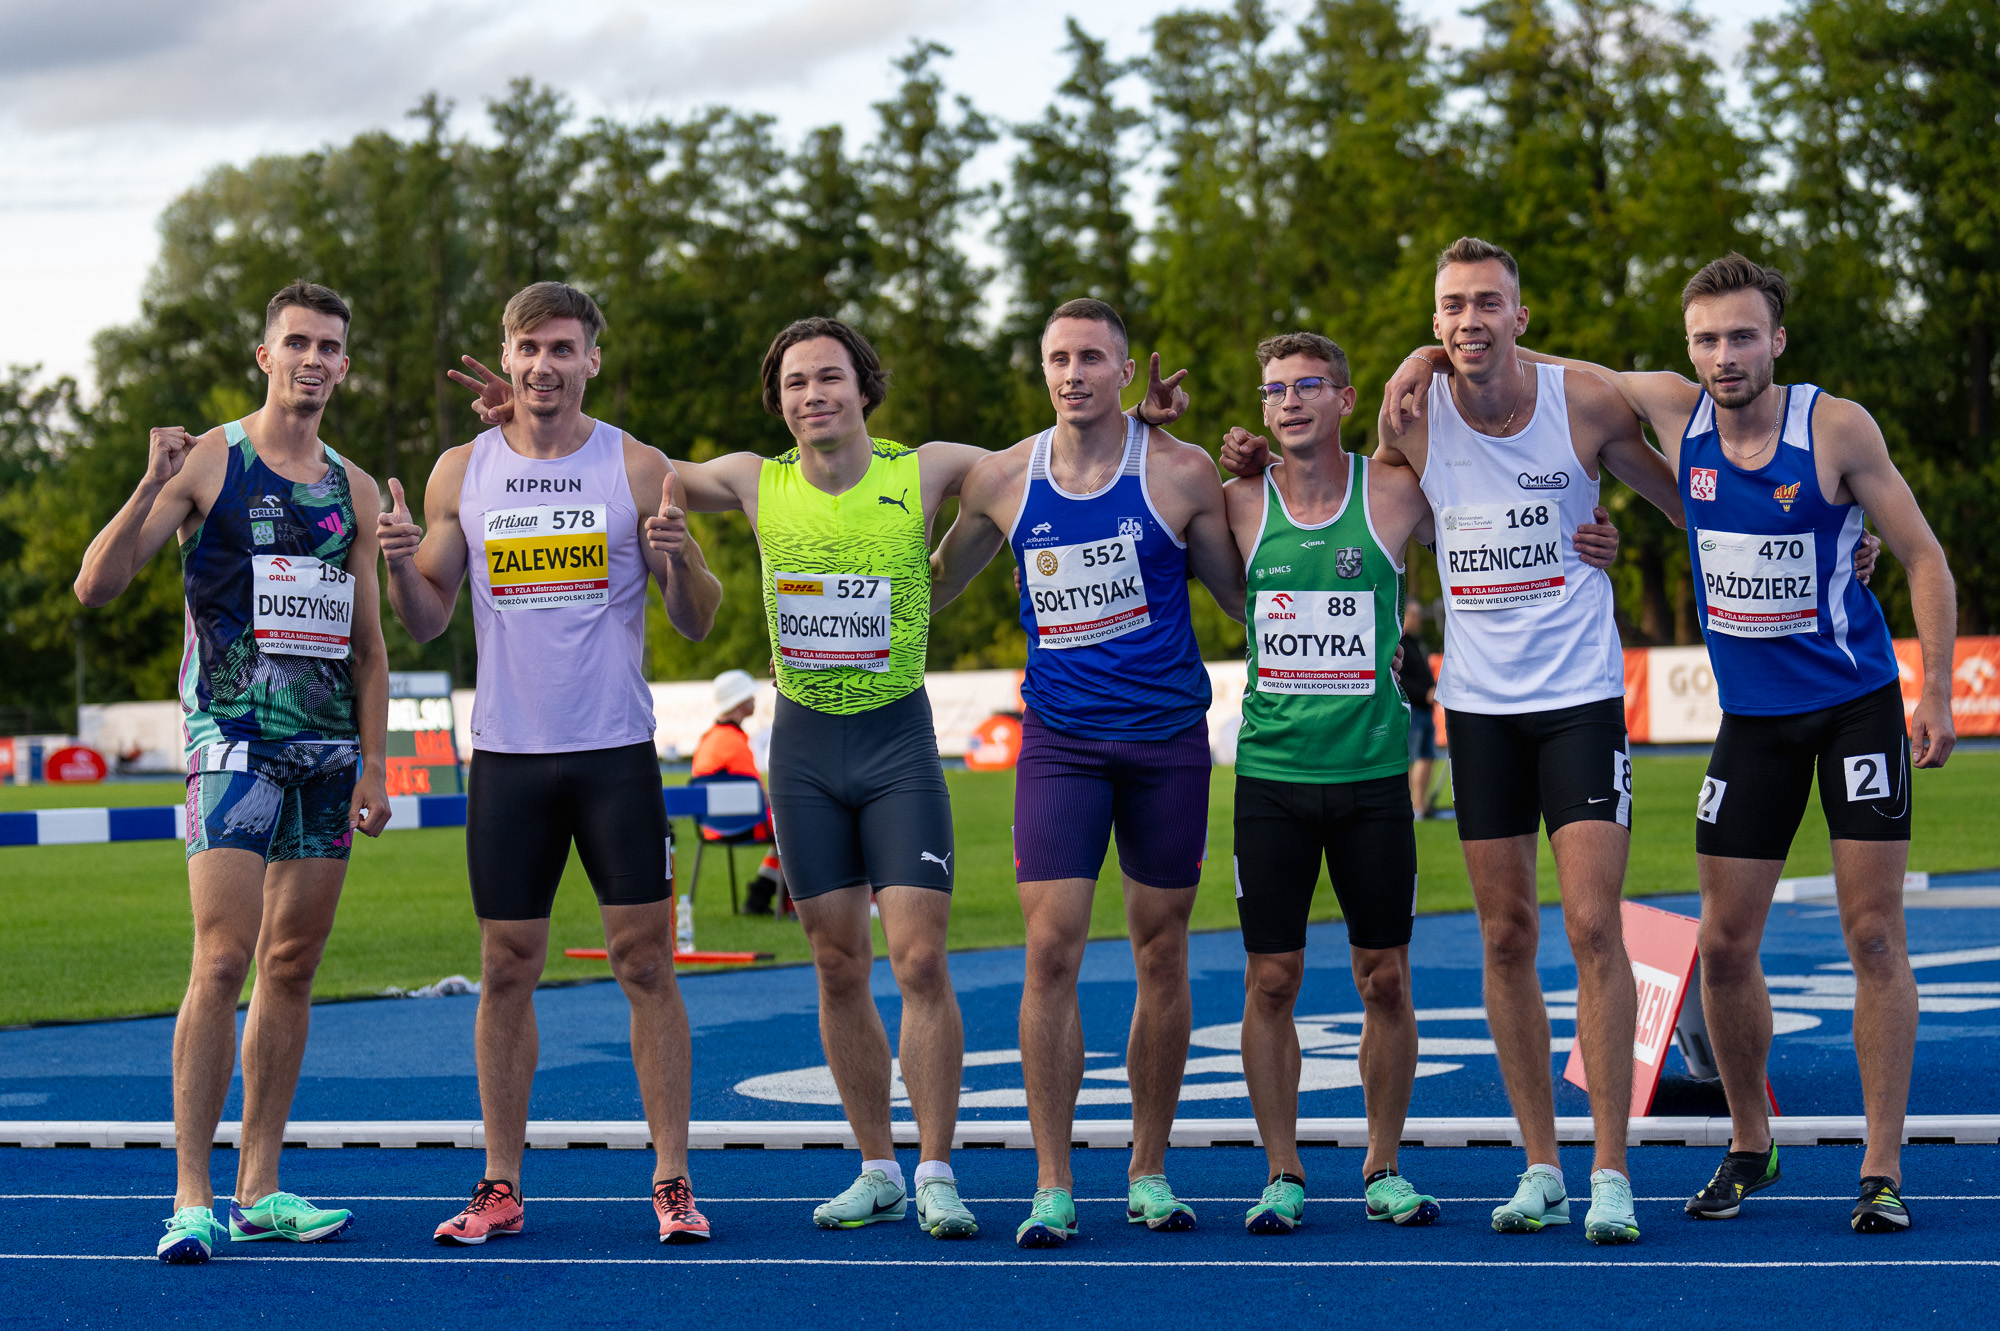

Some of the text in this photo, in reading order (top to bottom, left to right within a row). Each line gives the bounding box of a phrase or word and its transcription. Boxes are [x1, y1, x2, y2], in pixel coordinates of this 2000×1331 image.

[506, 479, 581, 492] KIPRUN
[1773, 481, 1800, 498] AWF
[488, 514, 538, 532] Artisan
[552, 510, 595, 530] 578
[1506, 506, 1548, 528] 168
[492, 544, 604, 574] ZALEWSKI
[1082, 542, 1126, 568] 552
[1449, 541, 1559, 573] RZEŹNICZAK
[1758, 540, 1804, 560] 470
[269, 574, 296, 582] ORLEN
[318, 562, 348, 584] 158
[1268, 565, 1291, 574] UMCS
[516, 586, 531, 594] PZLA
[532, 584, 574, 592] Mistrzostwa
[575, 582, 594, 590] Polski
[783, 584, 816, 592] DHL
[837, 580, 880, 598] 527
[1035, 576, 1139, 613] SOŁTYSIAK
[1472, 586, 1487, 594] PZLA
[1488, 584, 1530, 594] Mistrzostwa
[1530, 580, 1550, 588] Polski
[1706, 572, 1811, 600] PAŹDZIERZ
[498, 592, 603, 605] GORZÓW WIELKOPOLSKI 2023
[1328, 597, 1356, 617] 88
[1456, 590, 1561, 605] GORZÓW WIELKOPOLSKI 2023
[259, 594, 349, 623] DUSZYŃSKI
[1268, 612, 1296, 620] ORLEN
[1725, 612, 1737, 620] PZLA
[1738, 614, 1780, 622] Mistrzostwa
[1782, 612, 1802, 621] Polski
[780, 611, 885, 638] BOGACZYŃSKI
[1044, 618, 1145, 644] GORZÓW WIELKOPOLSKI 2023
[1059, 625, 1074, 633] PZLA
[1074, 618, 1114, 631] Mistrzostwa
[1115, 611, 1134, 622] Polski
[1712, 618, 1811, 632] GORZÓW WIELKOPOLSKI 2023
[296, 633, 329, 642] Mistrzostwa
[1264, 633, 1366, 656] KOTYRA
[294, 644, 334, 653] WIELKOPOLSKI
[785, 660, 811, 668] GORZÓW
[217, 741, 239, 769] 7
[1622, 759, 1632, 795] 8
[1853, 759, 1880, 797] 2
[1699, 780, 1716, 818] 2
